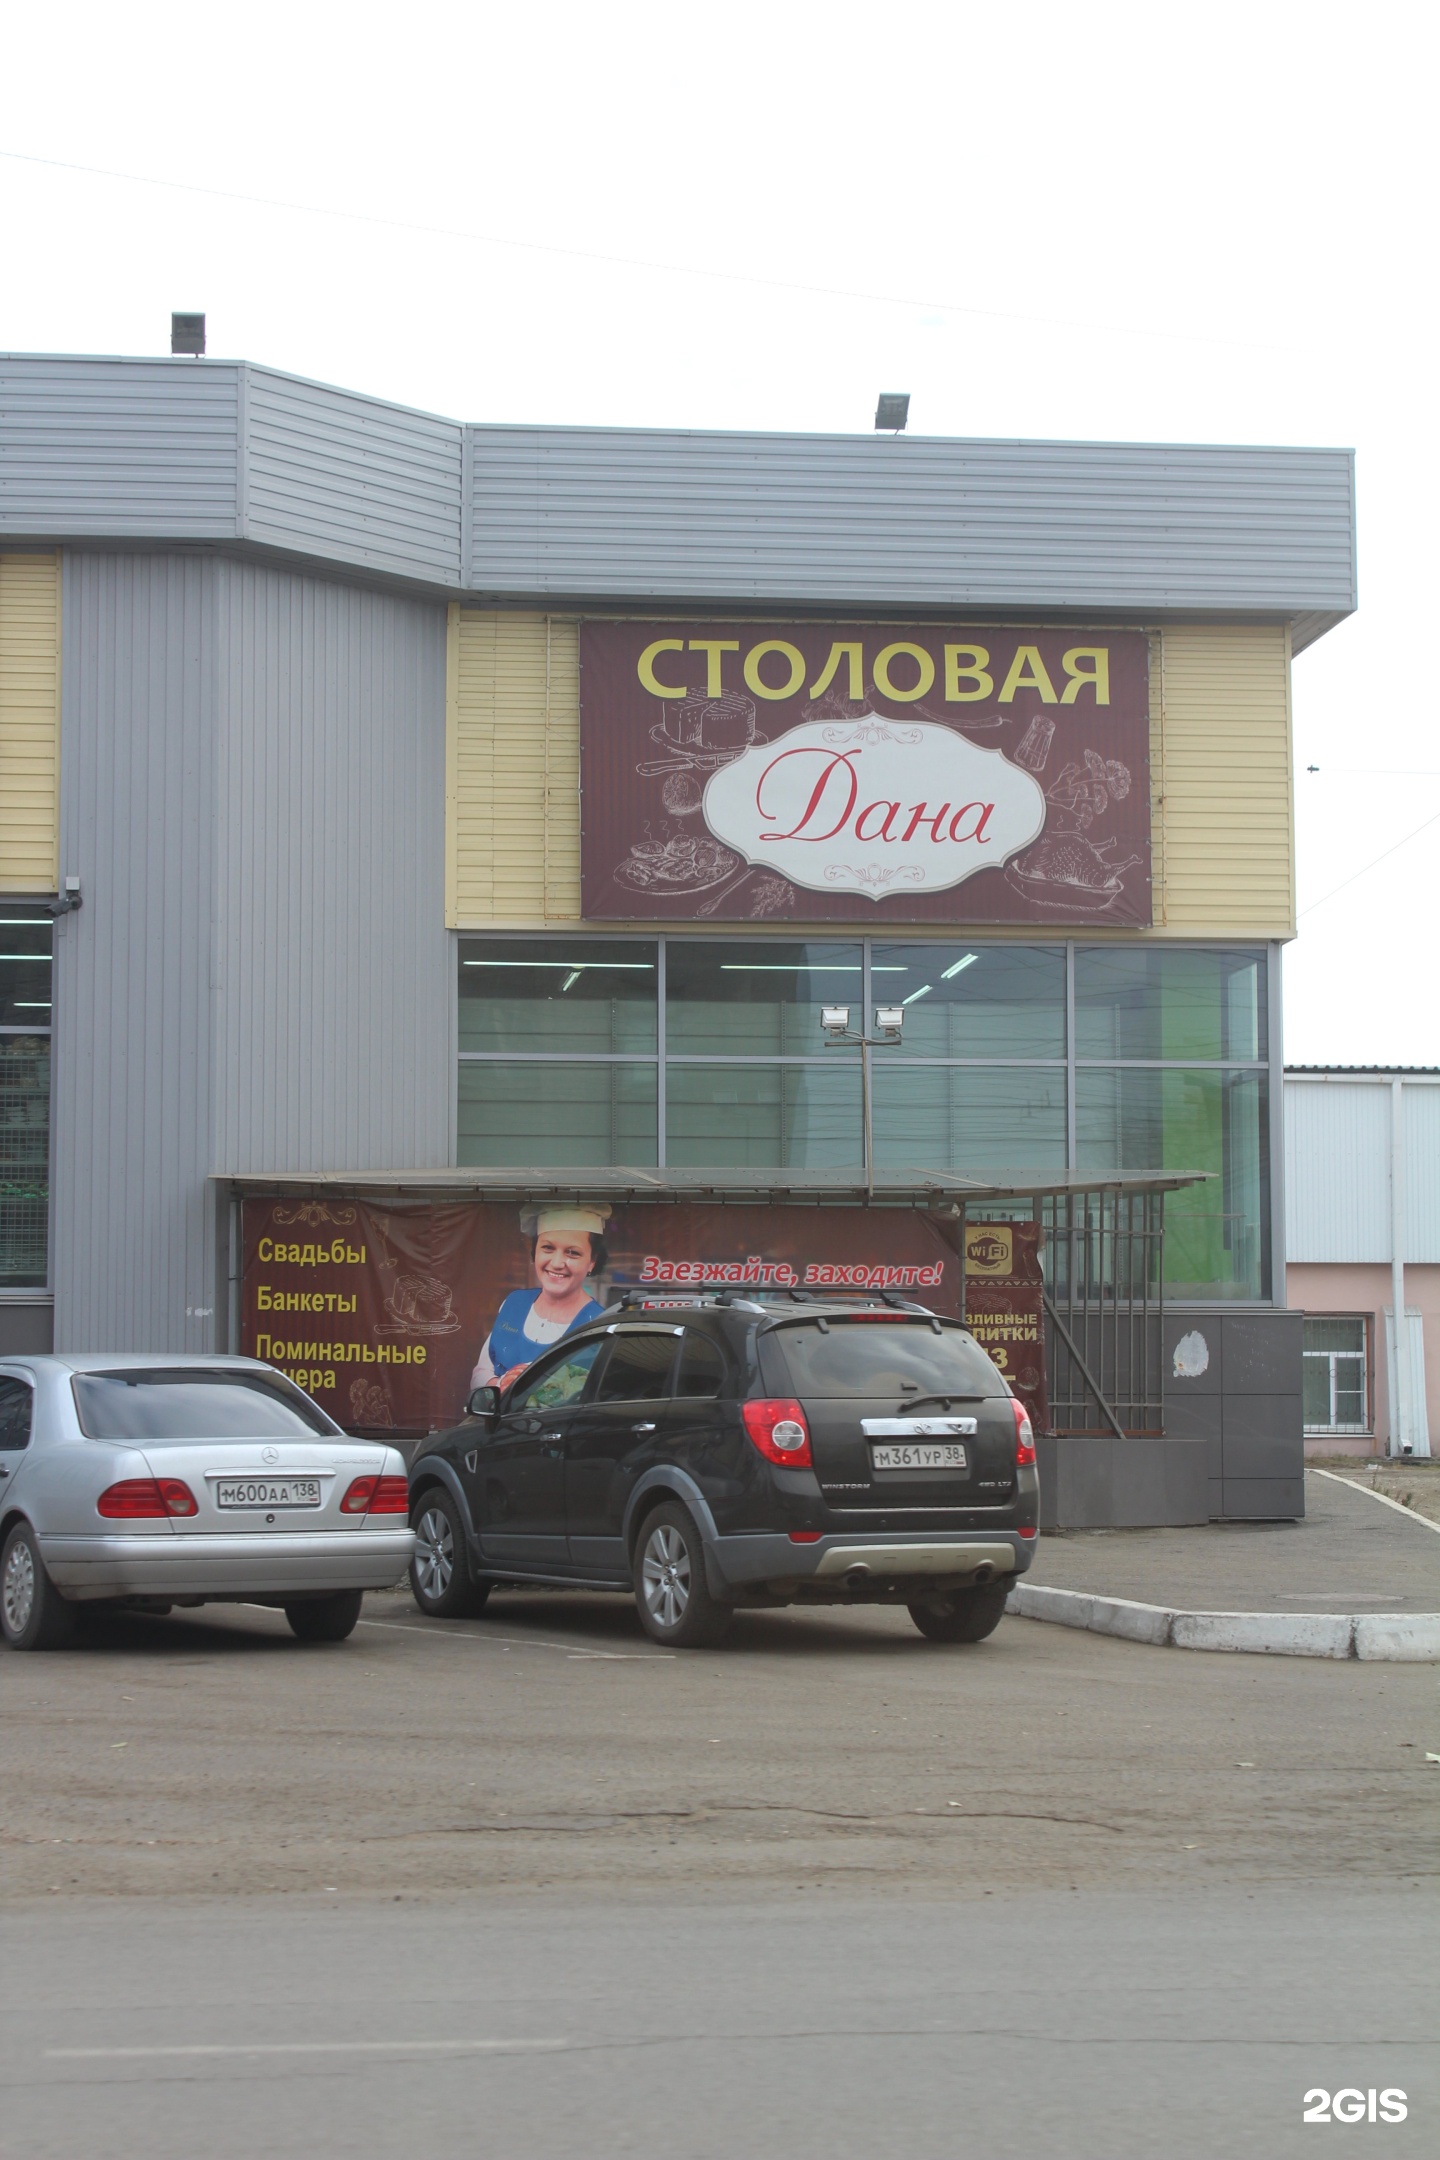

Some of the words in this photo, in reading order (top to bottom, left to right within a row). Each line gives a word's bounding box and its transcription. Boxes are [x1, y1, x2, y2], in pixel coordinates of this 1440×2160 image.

[637, 639, 1110, 705] СТОЛОВАЯ
[756, 747, 995, 844] Дана
[258, 1237, 366, 1267] Свадьбы
[640, 1256, 798, 1287] Заезжайте,
[804, 1260, 945, 1289] заходите!
[257, 1285, 357, 1313] Банкеты
[965, 1313, 1038, 1325] ЗЛИВНЫЕ
[972, 1327, 1037, 1341] ПИТКИ
[256, 1333, 427, 1365] Поминальные
[282, 1368, 336, 1394] чера
